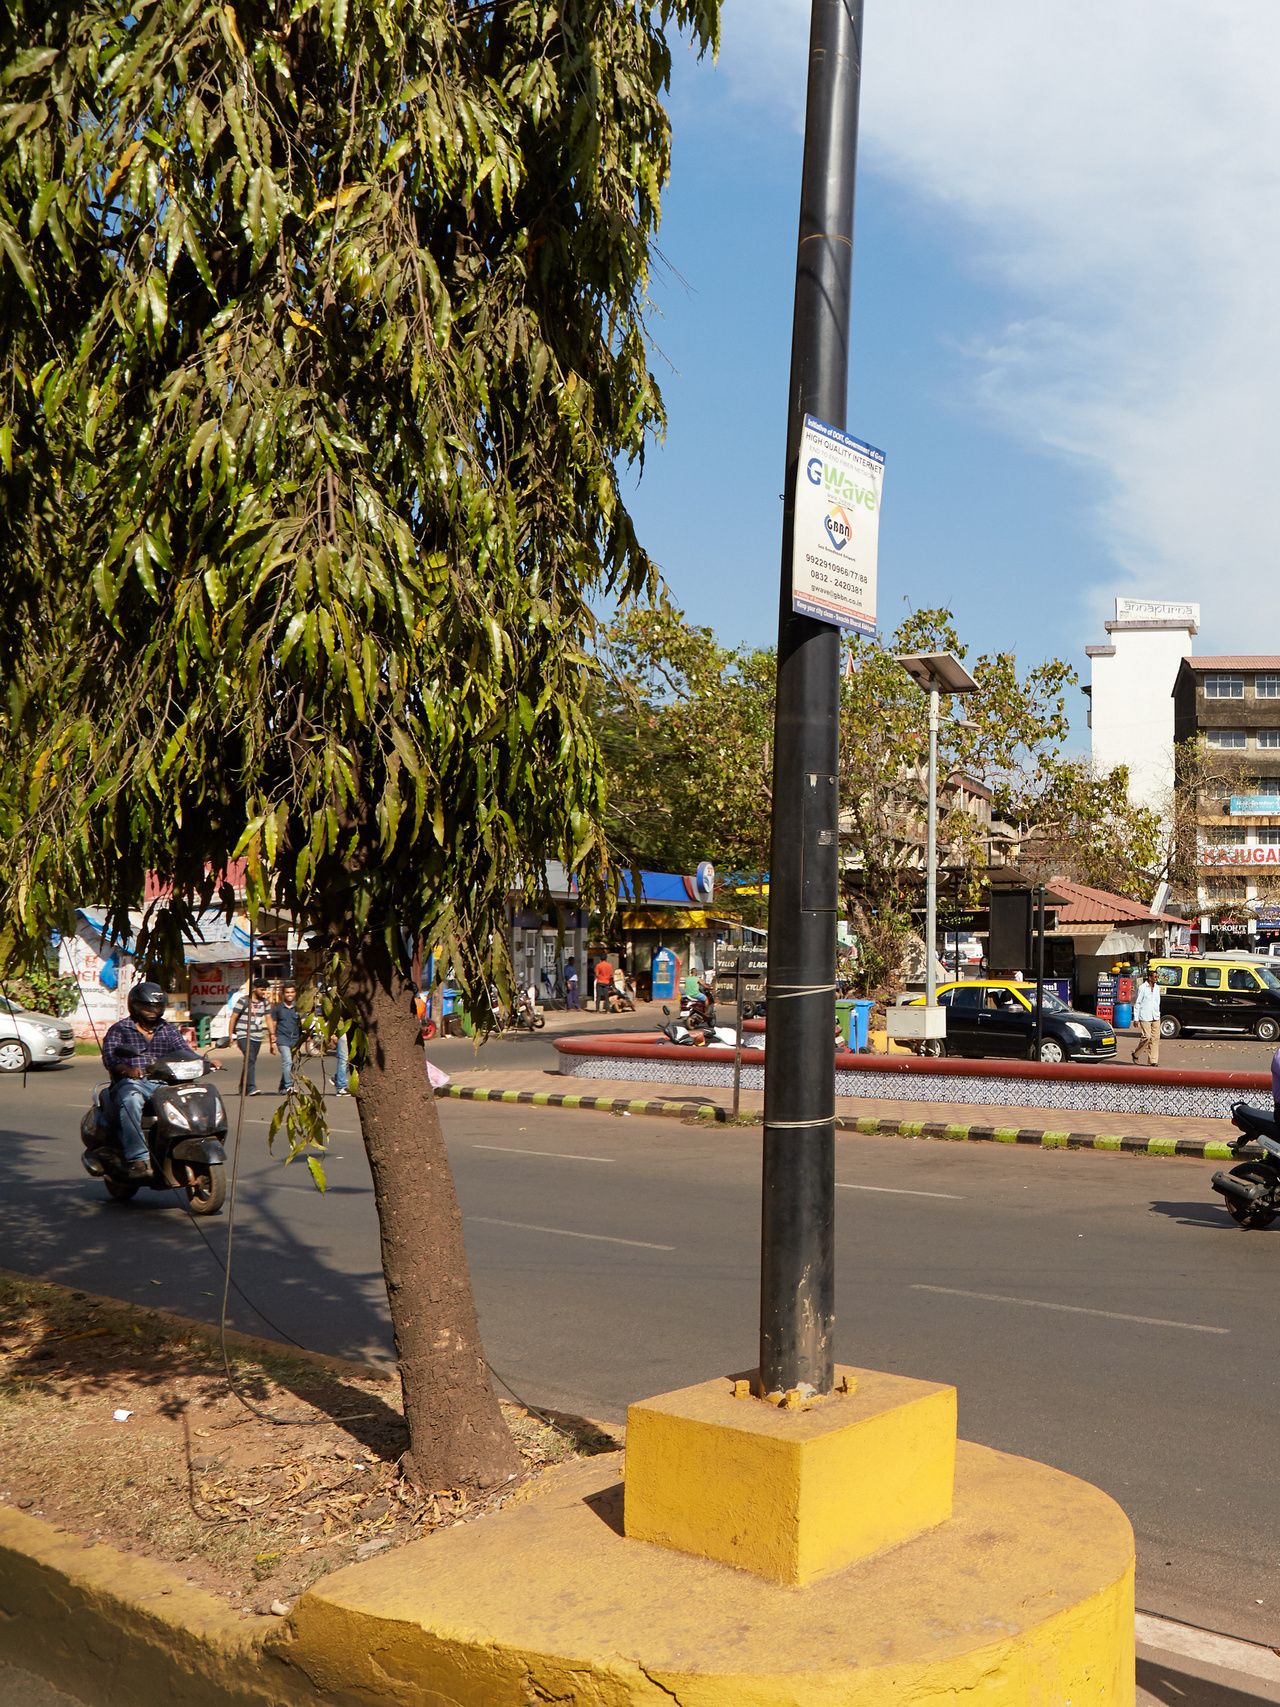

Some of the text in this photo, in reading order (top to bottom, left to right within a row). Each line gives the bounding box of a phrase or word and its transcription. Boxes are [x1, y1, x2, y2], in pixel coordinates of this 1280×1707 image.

[806, 432, 882, 474] HIGH QUALITY INTERNET
[810, 445, 820, 454] END
[829, 454, 839, 463] END
[806, 554, 868, 584] 9922910966/77/88
[811, 570, 828, 583] 0832
[835, 579, 862, 595] 2420381
